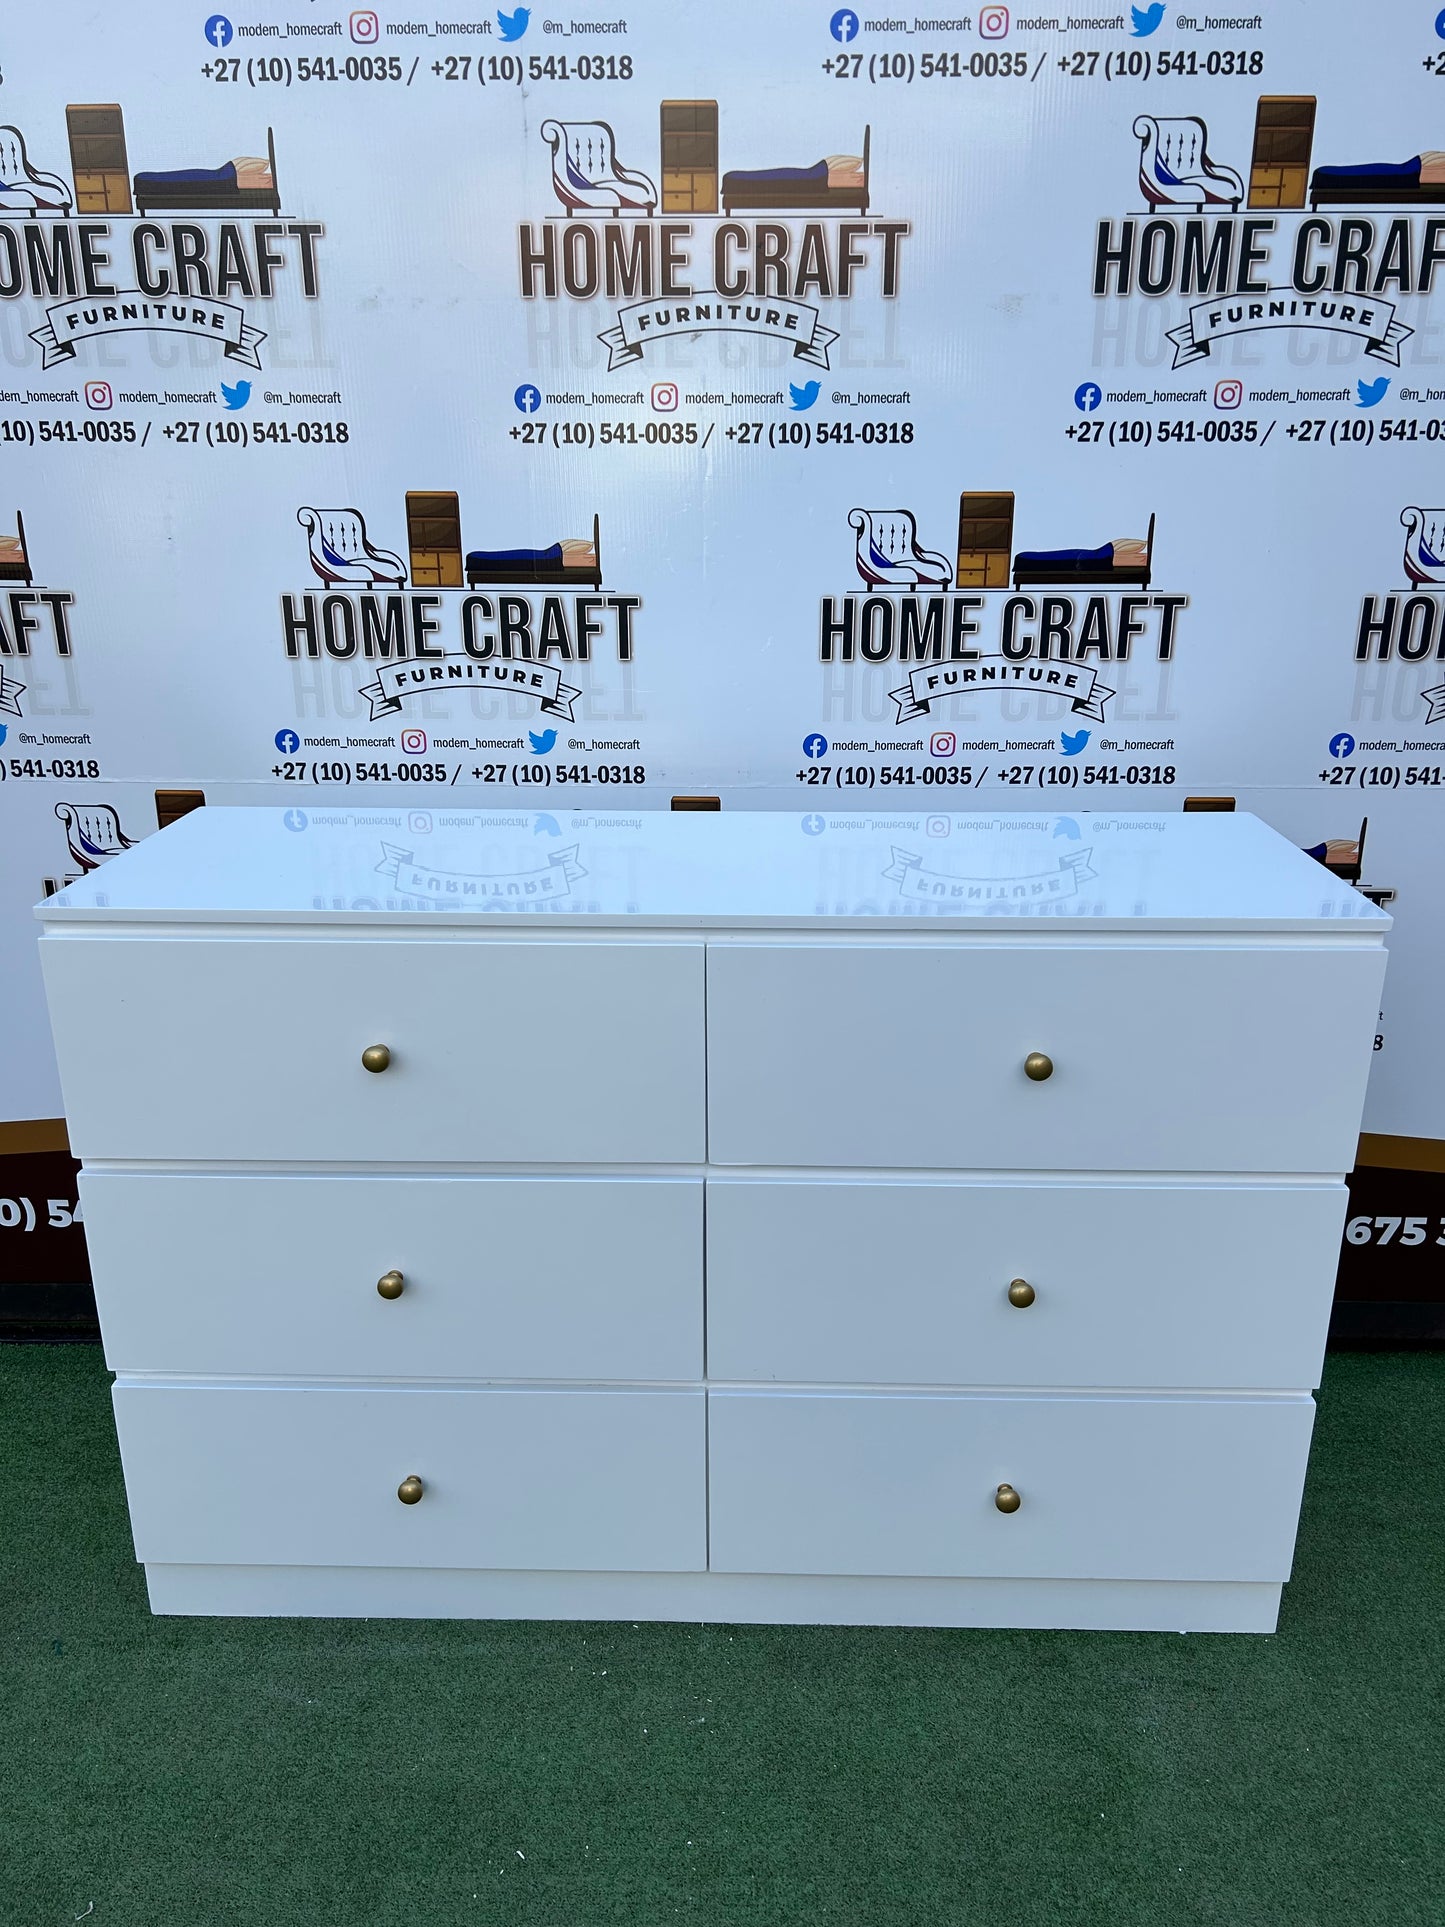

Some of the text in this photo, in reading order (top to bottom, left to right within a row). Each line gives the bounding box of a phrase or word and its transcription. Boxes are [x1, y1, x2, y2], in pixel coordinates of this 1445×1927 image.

[543, 19, 627, 36] @m_homecraft
[1176, 15, 1262, 32] @m_homecraft
[201, 55, 633, 87] +27 (10) 541-0035 / +27 (10) 541-0318
[822, 51, 1263, 84] +27 (10) 541-0035 / +27 (10) 541-0318
[132, 223, 324, 299] CRAFT
[520, 224, 911, 301] HOME CRAFT
[1094, 219, 1445, 298] HOME CRAF
[66, 304, 224, 330] FURNITURE
[638, 305, 799, 331] FURNITURE
[1209, 301, 1374, 328] FURNITURE
[264, 391, 342, 406] @m_homecraft
[832, 391, 910, 406] @m_homecraft
[0, 420, 349, 448] 10) 541-0035 / +27 (10) 541-0318
[509, 422, 914, 449] +27 (10) 541-0035 / +27 (10) 541-0318
[1065, 421, 1104, 442] +27
[1109, 421, 1152, 447] (10)
[1157, 420, 1258, 442] 541-0035
[1259, 420, 1277, 447] /
[1286, 420, 1326, 441] +27
[1330, 420, 1374, 446] (10)
[282, 595, 641, 662] HOME CRAFT
[821, 597, 1188, 664] HOME CRAFT
[1356, 596, 1445, 663] HO
[395, 665, 543, 688] FURNITURE
[927, 666, 1078, 690] FURNITURE
[19, 733, 91, 746] @m_homecraft
[568, 738, 640, 751] @m_homecraft
[1100, 739, 1174, 752] @m_homecraft
[10, 759, 99, 778] 541-0318
[272, 762, 645, 787] +27 (10) 541-0035 / +27 (10) 541-0318
[796, 766, 1176, 788] +27 (10) 541-0035 / +27 (10) 541-0318
[1319, 766, 1356, 785] +27
[1360, 767, 1400, 789] (10)
[1346, 1216, 1428, 1246] 675
